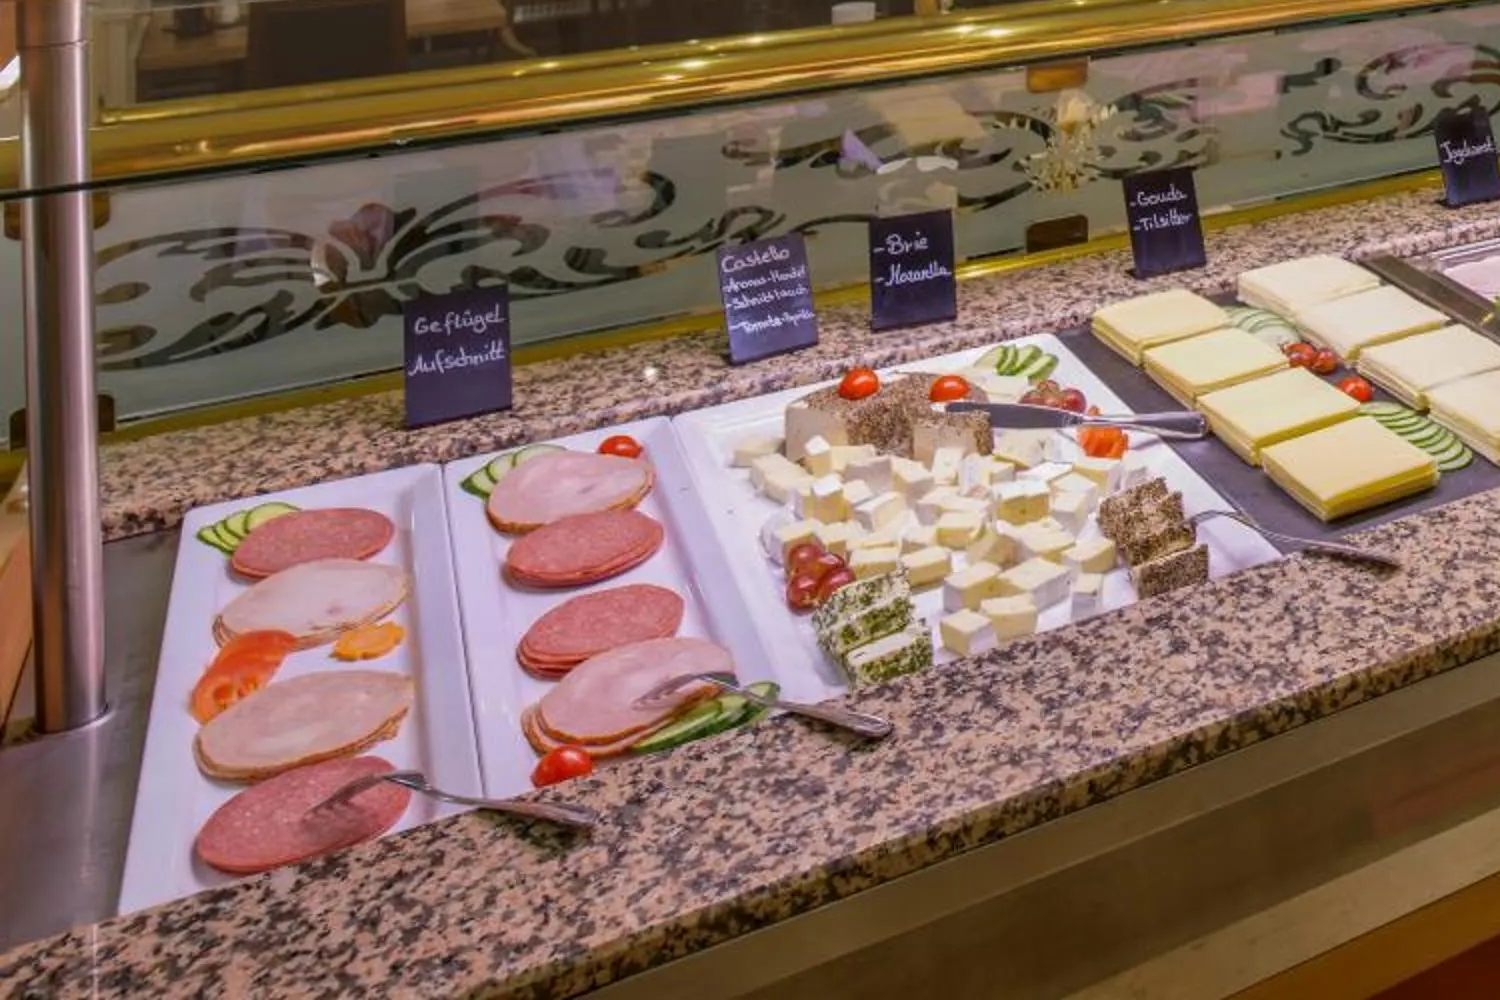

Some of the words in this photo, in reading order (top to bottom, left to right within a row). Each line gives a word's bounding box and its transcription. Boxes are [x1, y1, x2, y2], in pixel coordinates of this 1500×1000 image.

[721, 245, 790, 273] Castello
[414, 303, 504, 336] Geflügel
[408, 339, 506, 376] Aufschnitt
